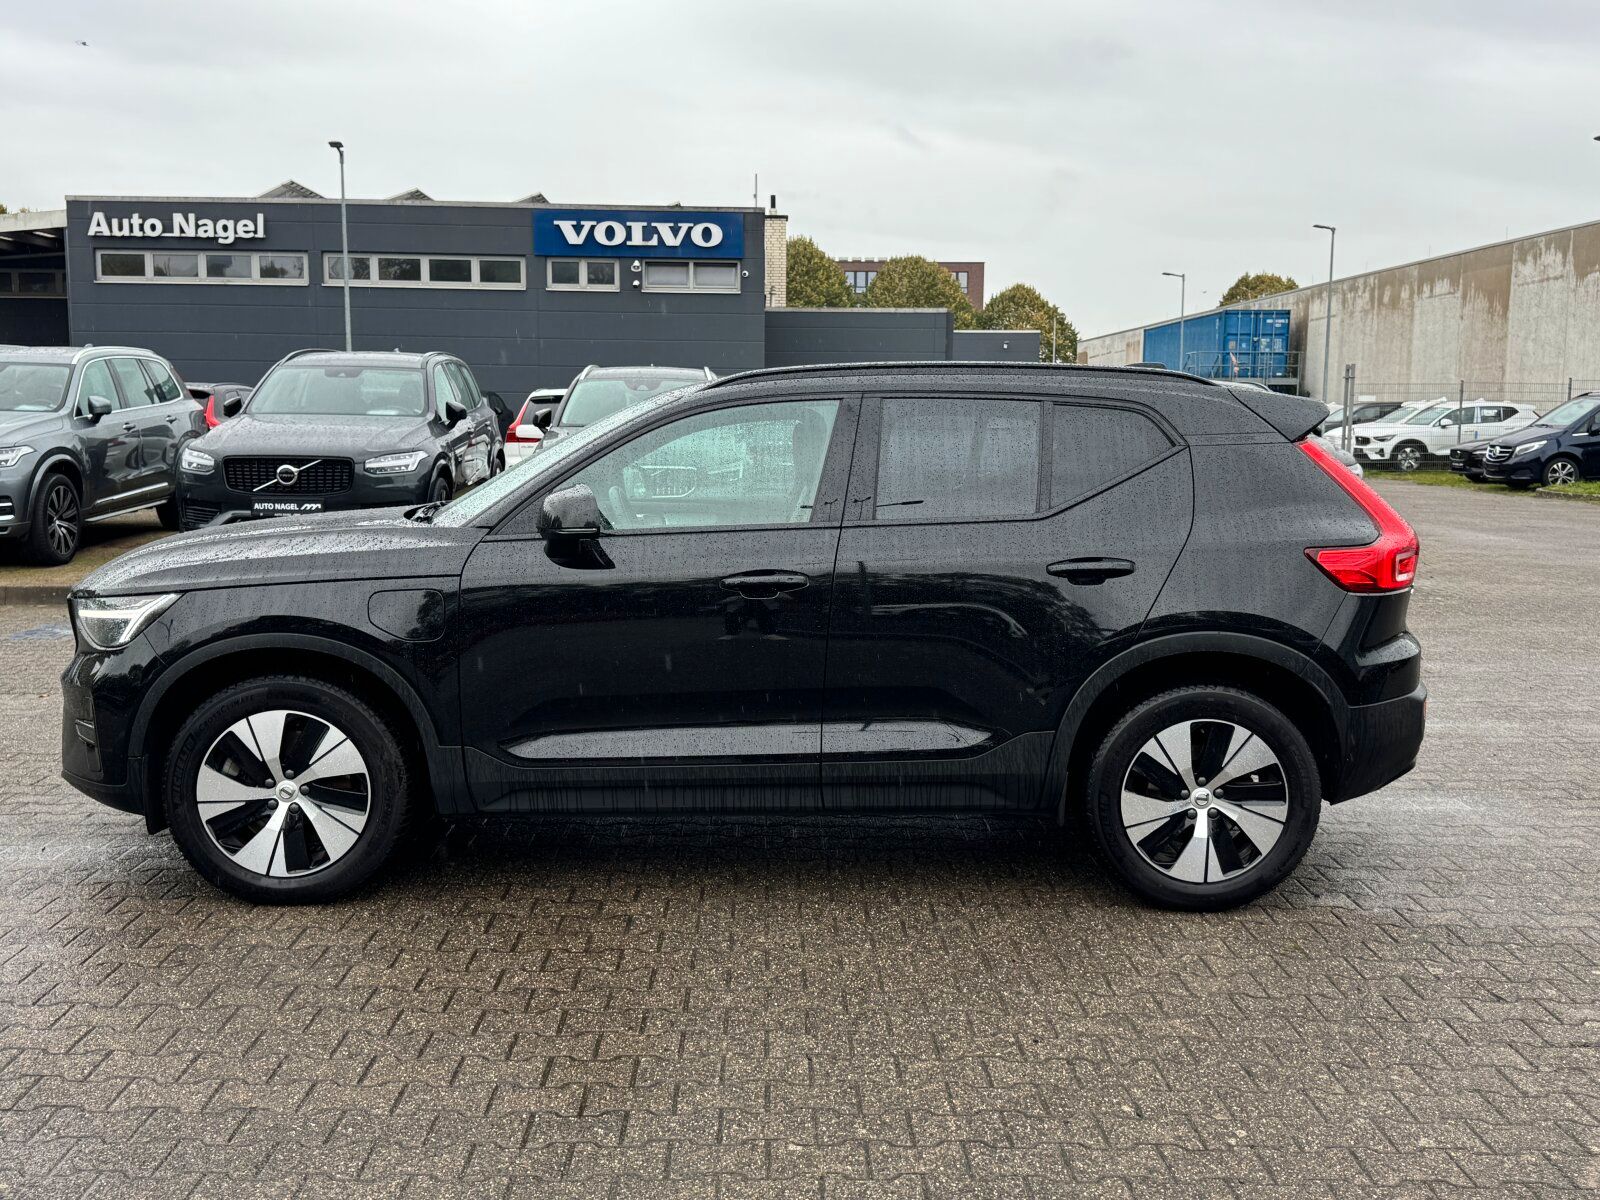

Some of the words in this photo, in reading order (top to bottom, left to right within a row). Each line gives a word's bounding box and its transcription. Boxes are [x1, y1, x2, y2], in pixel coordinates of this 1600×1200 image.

[87, 211, 163, 238] Auto
[172, 212, 265, 244] Nagel
[553, 220, 723, 248] VOLVO
